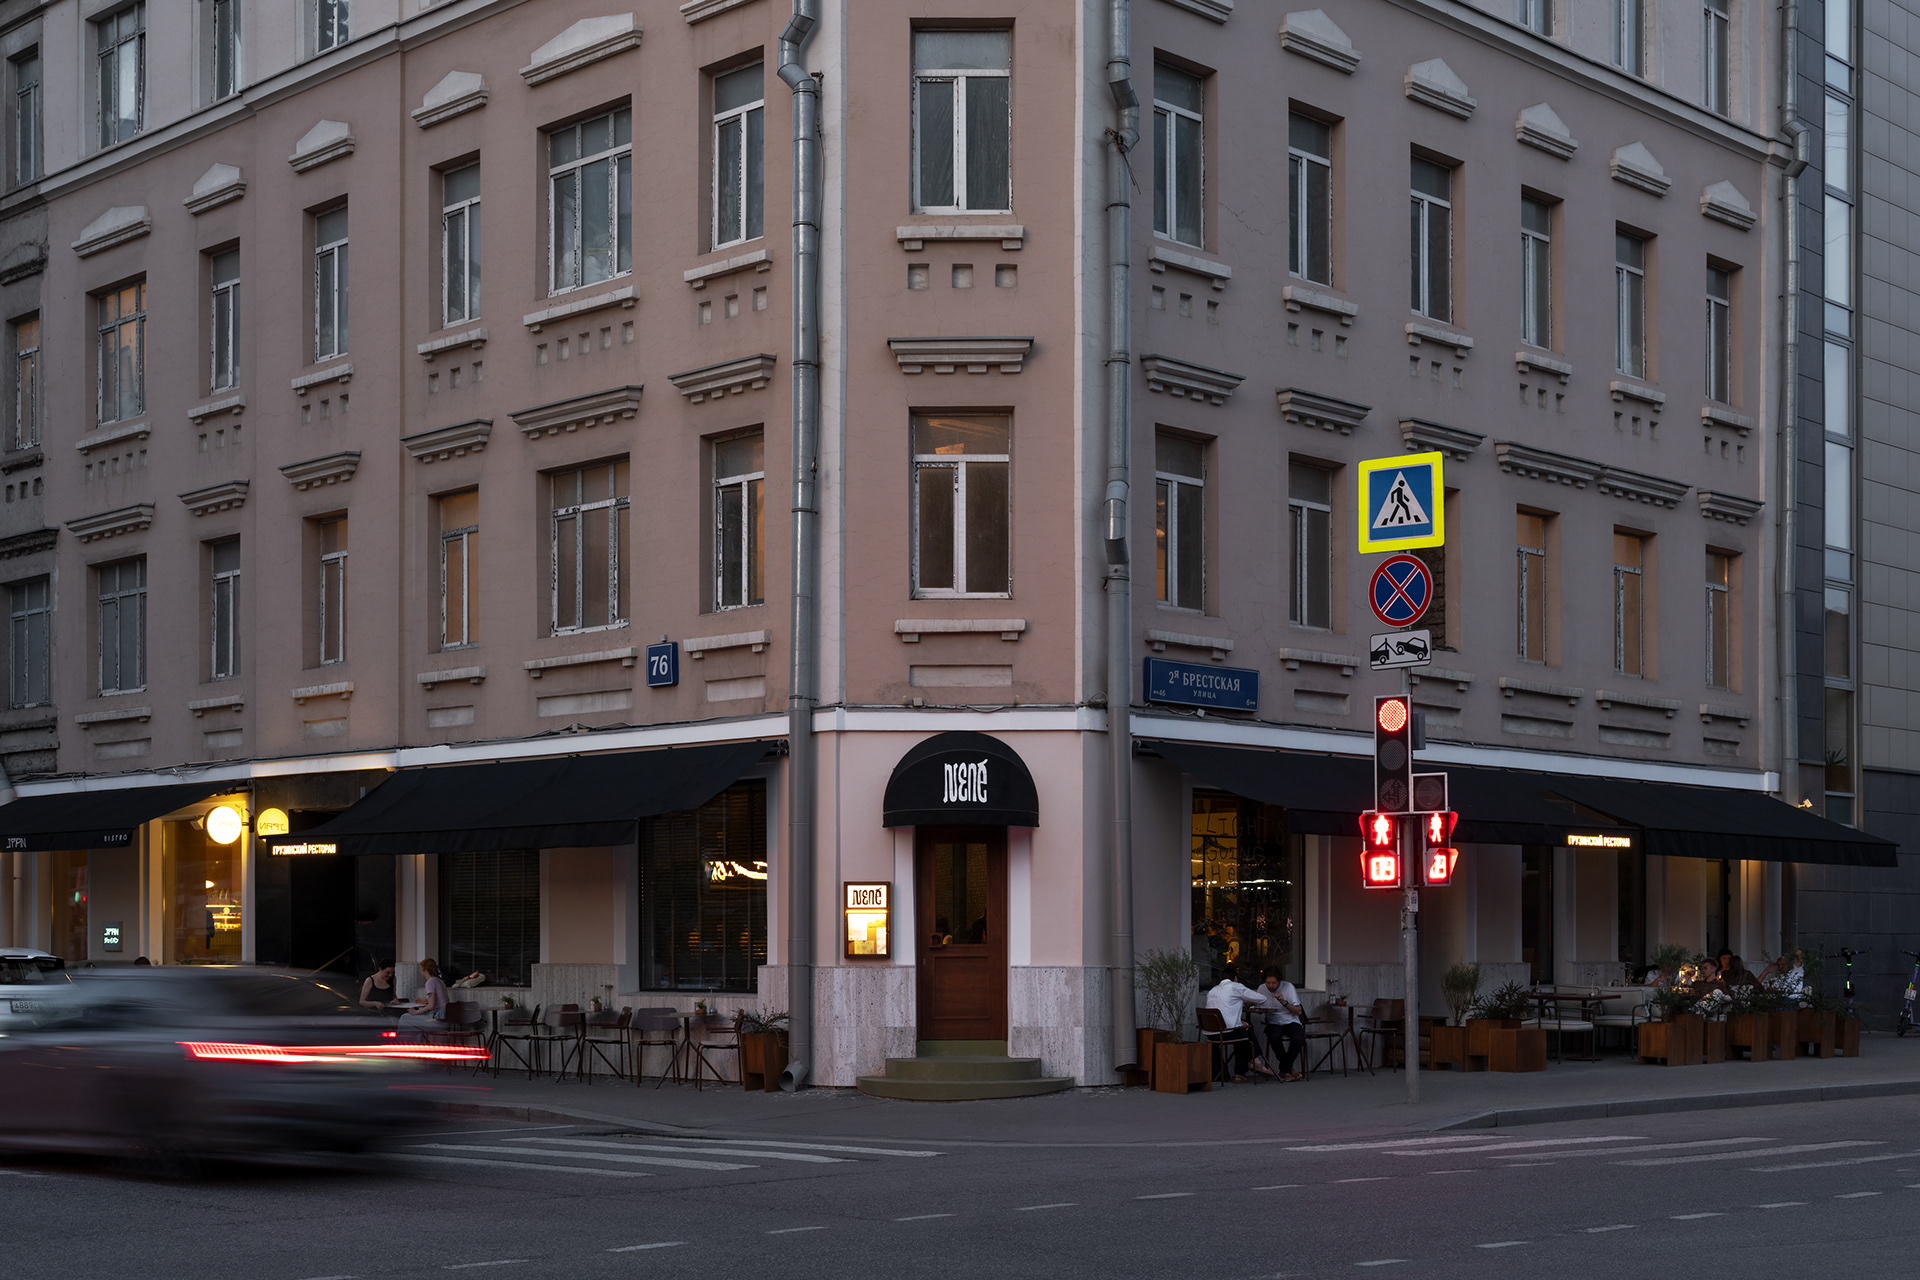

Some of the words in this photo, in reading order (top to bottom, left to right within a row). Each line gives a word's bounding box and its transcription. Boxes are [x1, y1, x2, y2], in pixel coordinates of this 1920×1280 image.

[650, 654, 668, 676] 76
[1183, 672, 1241, 692] БРЕСТСКАЯ
[1193, 689, 1217, 699] УЛИЦА
[103, 834, 128, 842] BISTRO
[1567, 834, 1604, 847] ГРУЗИНСКИЙ
[1604, 836, 1631, 848] РЕСТОРАН
[272, 842, 308, 856] ГРУЗИНСКИЙ
[308, 843, 337, 855] РЕСТОРАН
